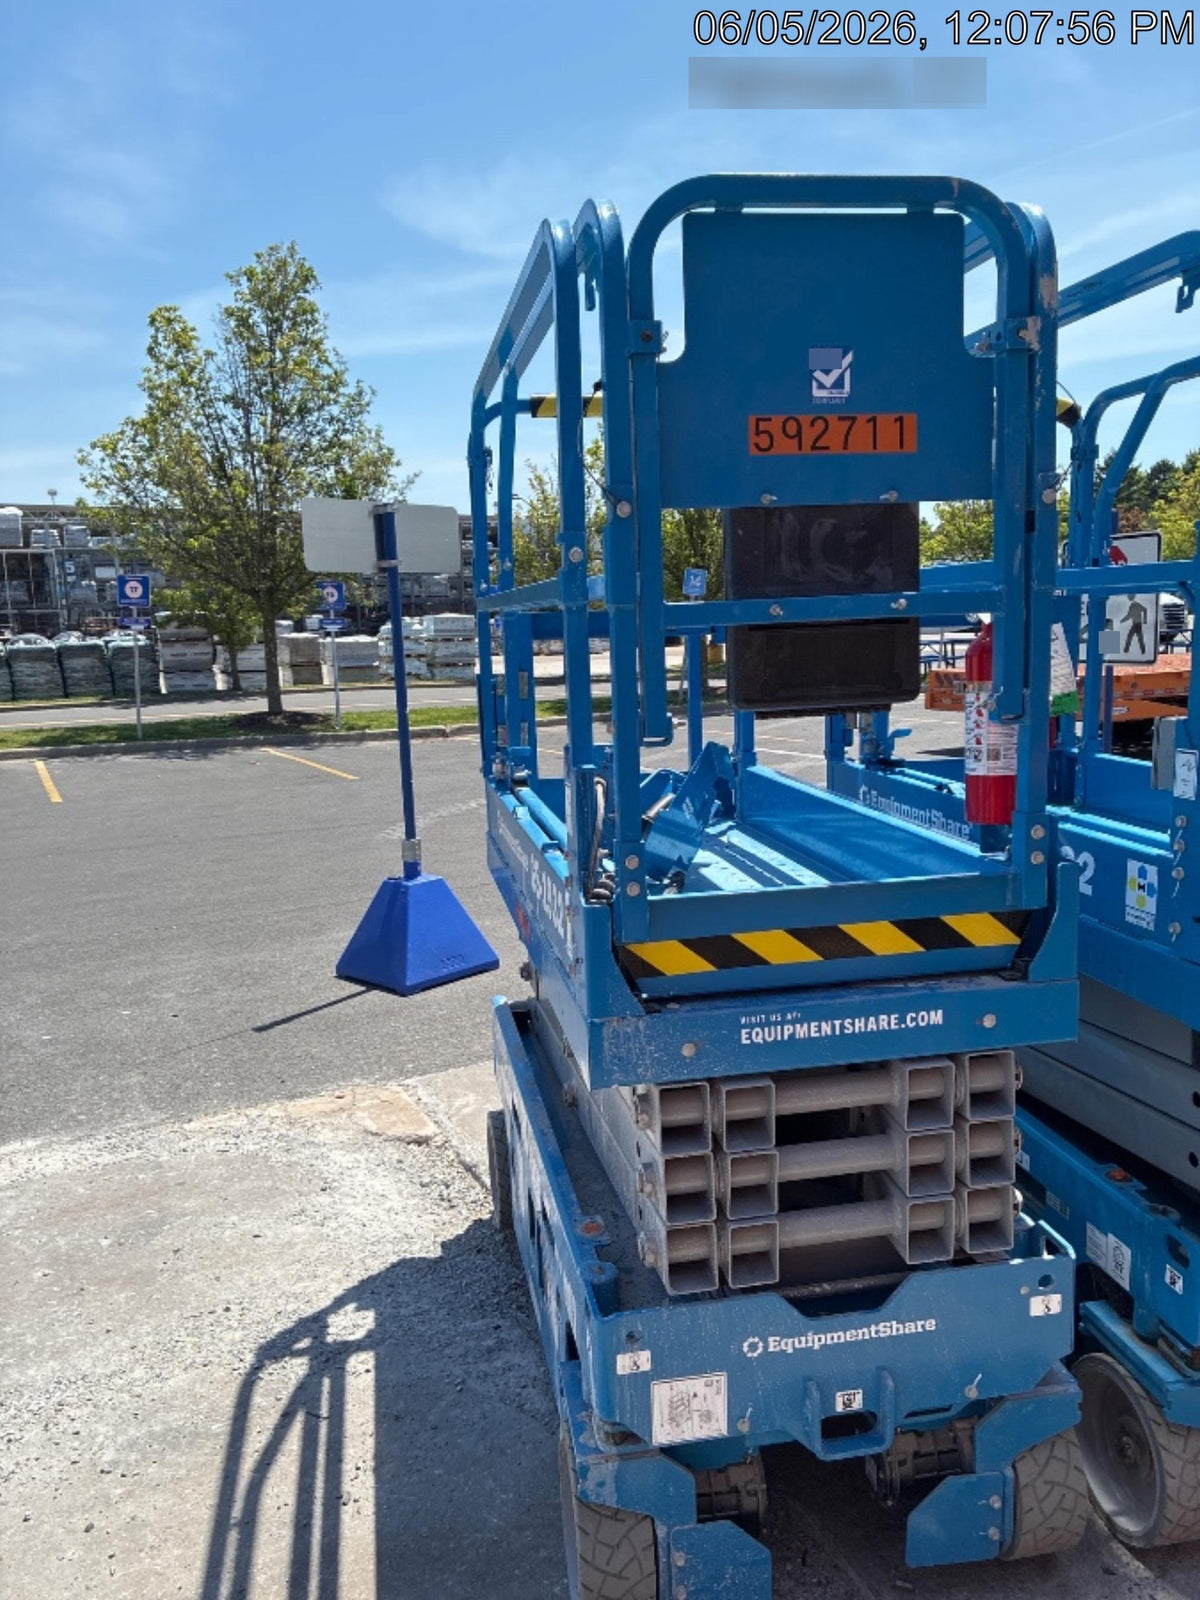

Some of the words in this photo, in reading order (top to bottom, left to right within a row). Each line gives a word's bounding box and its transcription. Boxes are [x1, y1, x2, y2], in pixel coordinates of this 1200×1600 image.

[753, 414, 905, 453] 592711
[740, 1014, 766, 1025] VISIT
[769, 1013, 782, 1022] US
[740, 1009, 944, 1045] EQUIPMENTSHARE.COM
[767, 1318, 937, 1354] EquipmentShare
